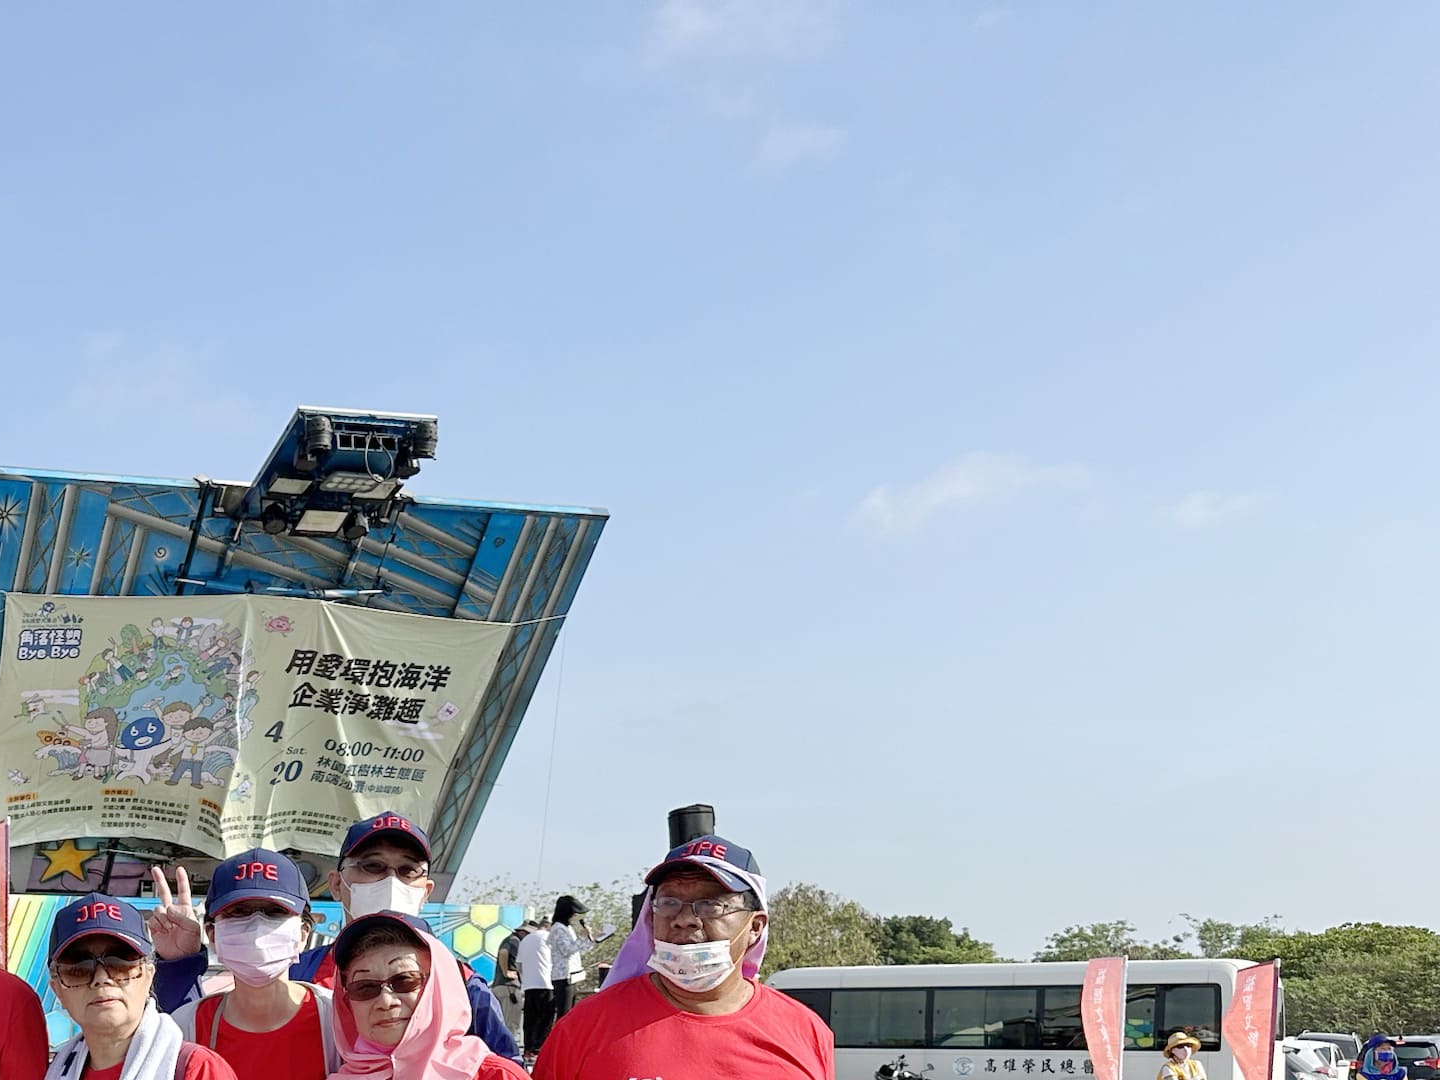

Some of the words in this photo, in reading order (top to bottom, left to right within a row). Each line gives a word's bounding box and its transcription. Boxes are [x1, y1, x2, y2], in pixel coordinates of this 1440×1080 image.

[19, 647, 47, 660] Bye
[51, 646, 79, 659] Bye
[285, 649, 451, 692] 用愛環抱海洋
[288, 682, 426, 724] 企業淨灘趣
[264, 720, 285, 743] 4
[324, 738, 425, 763] 08:00~11:00
[269, 760, 303, 786] 20
[372, 816, 411, 831] JPE
[681, 840, 728, 860] JPE
[234, 861, 279, 881] JPE
[76, 901, 123, 922] JPE
